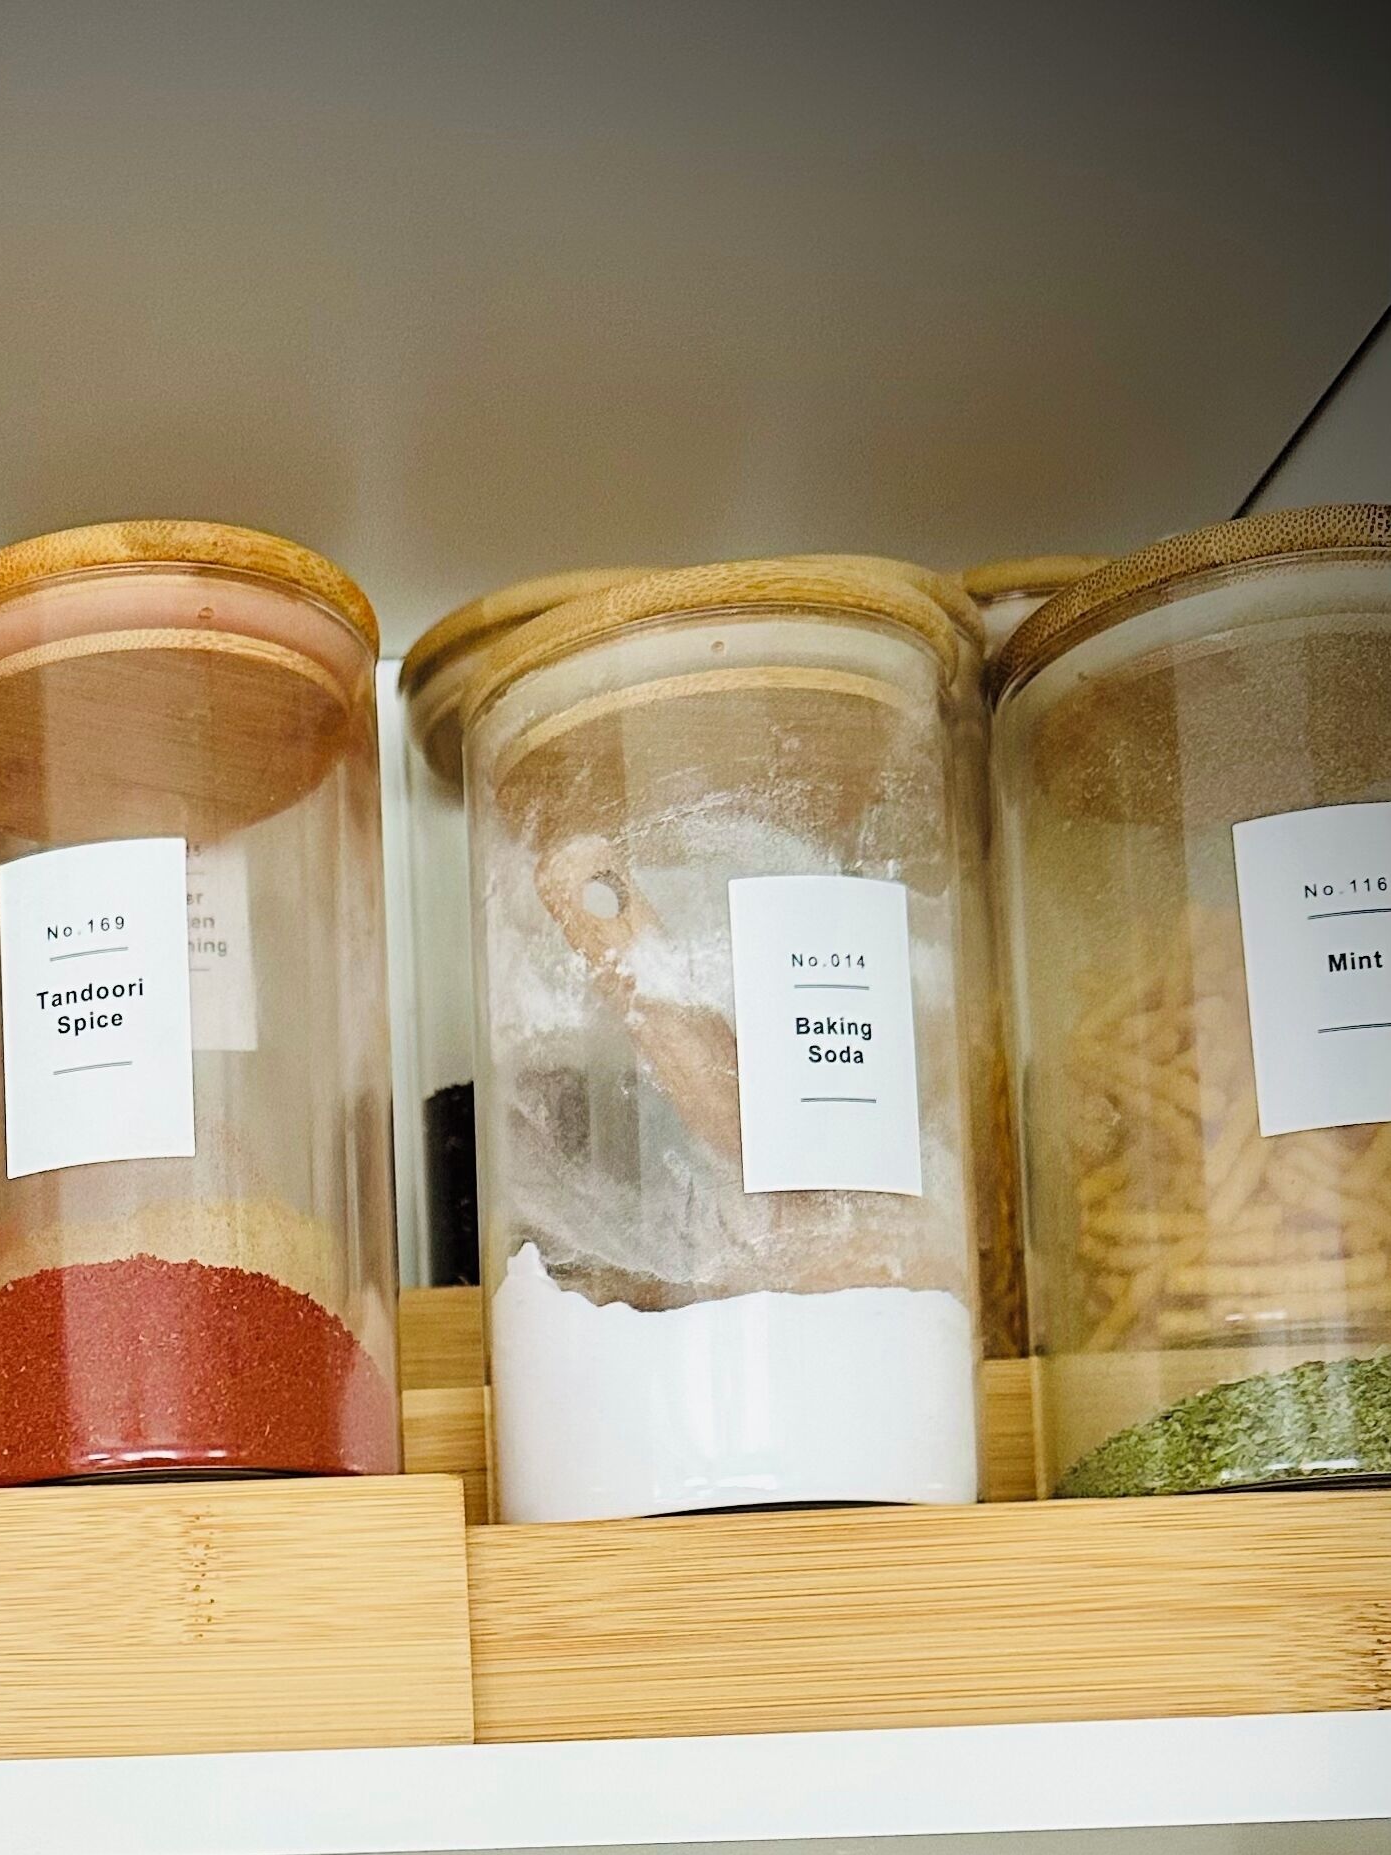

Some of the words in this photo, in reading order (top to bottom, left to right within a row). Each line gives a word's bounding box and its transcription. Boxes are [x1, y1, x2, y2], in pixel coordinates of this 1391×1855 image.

[1304, 876, 1388, 899] No.116
[47, 916, 125, 940] No.169
[791, 953, 865, 969] No.014
[1327, 950, 1384, 973] Mint
[36, 978, 144, 1010] Tandoori
[57, 1011, 123, 1037] Spice
[795, 1016, 872, 1041] Baking
[808, 1044, 864, 1064] Soda
